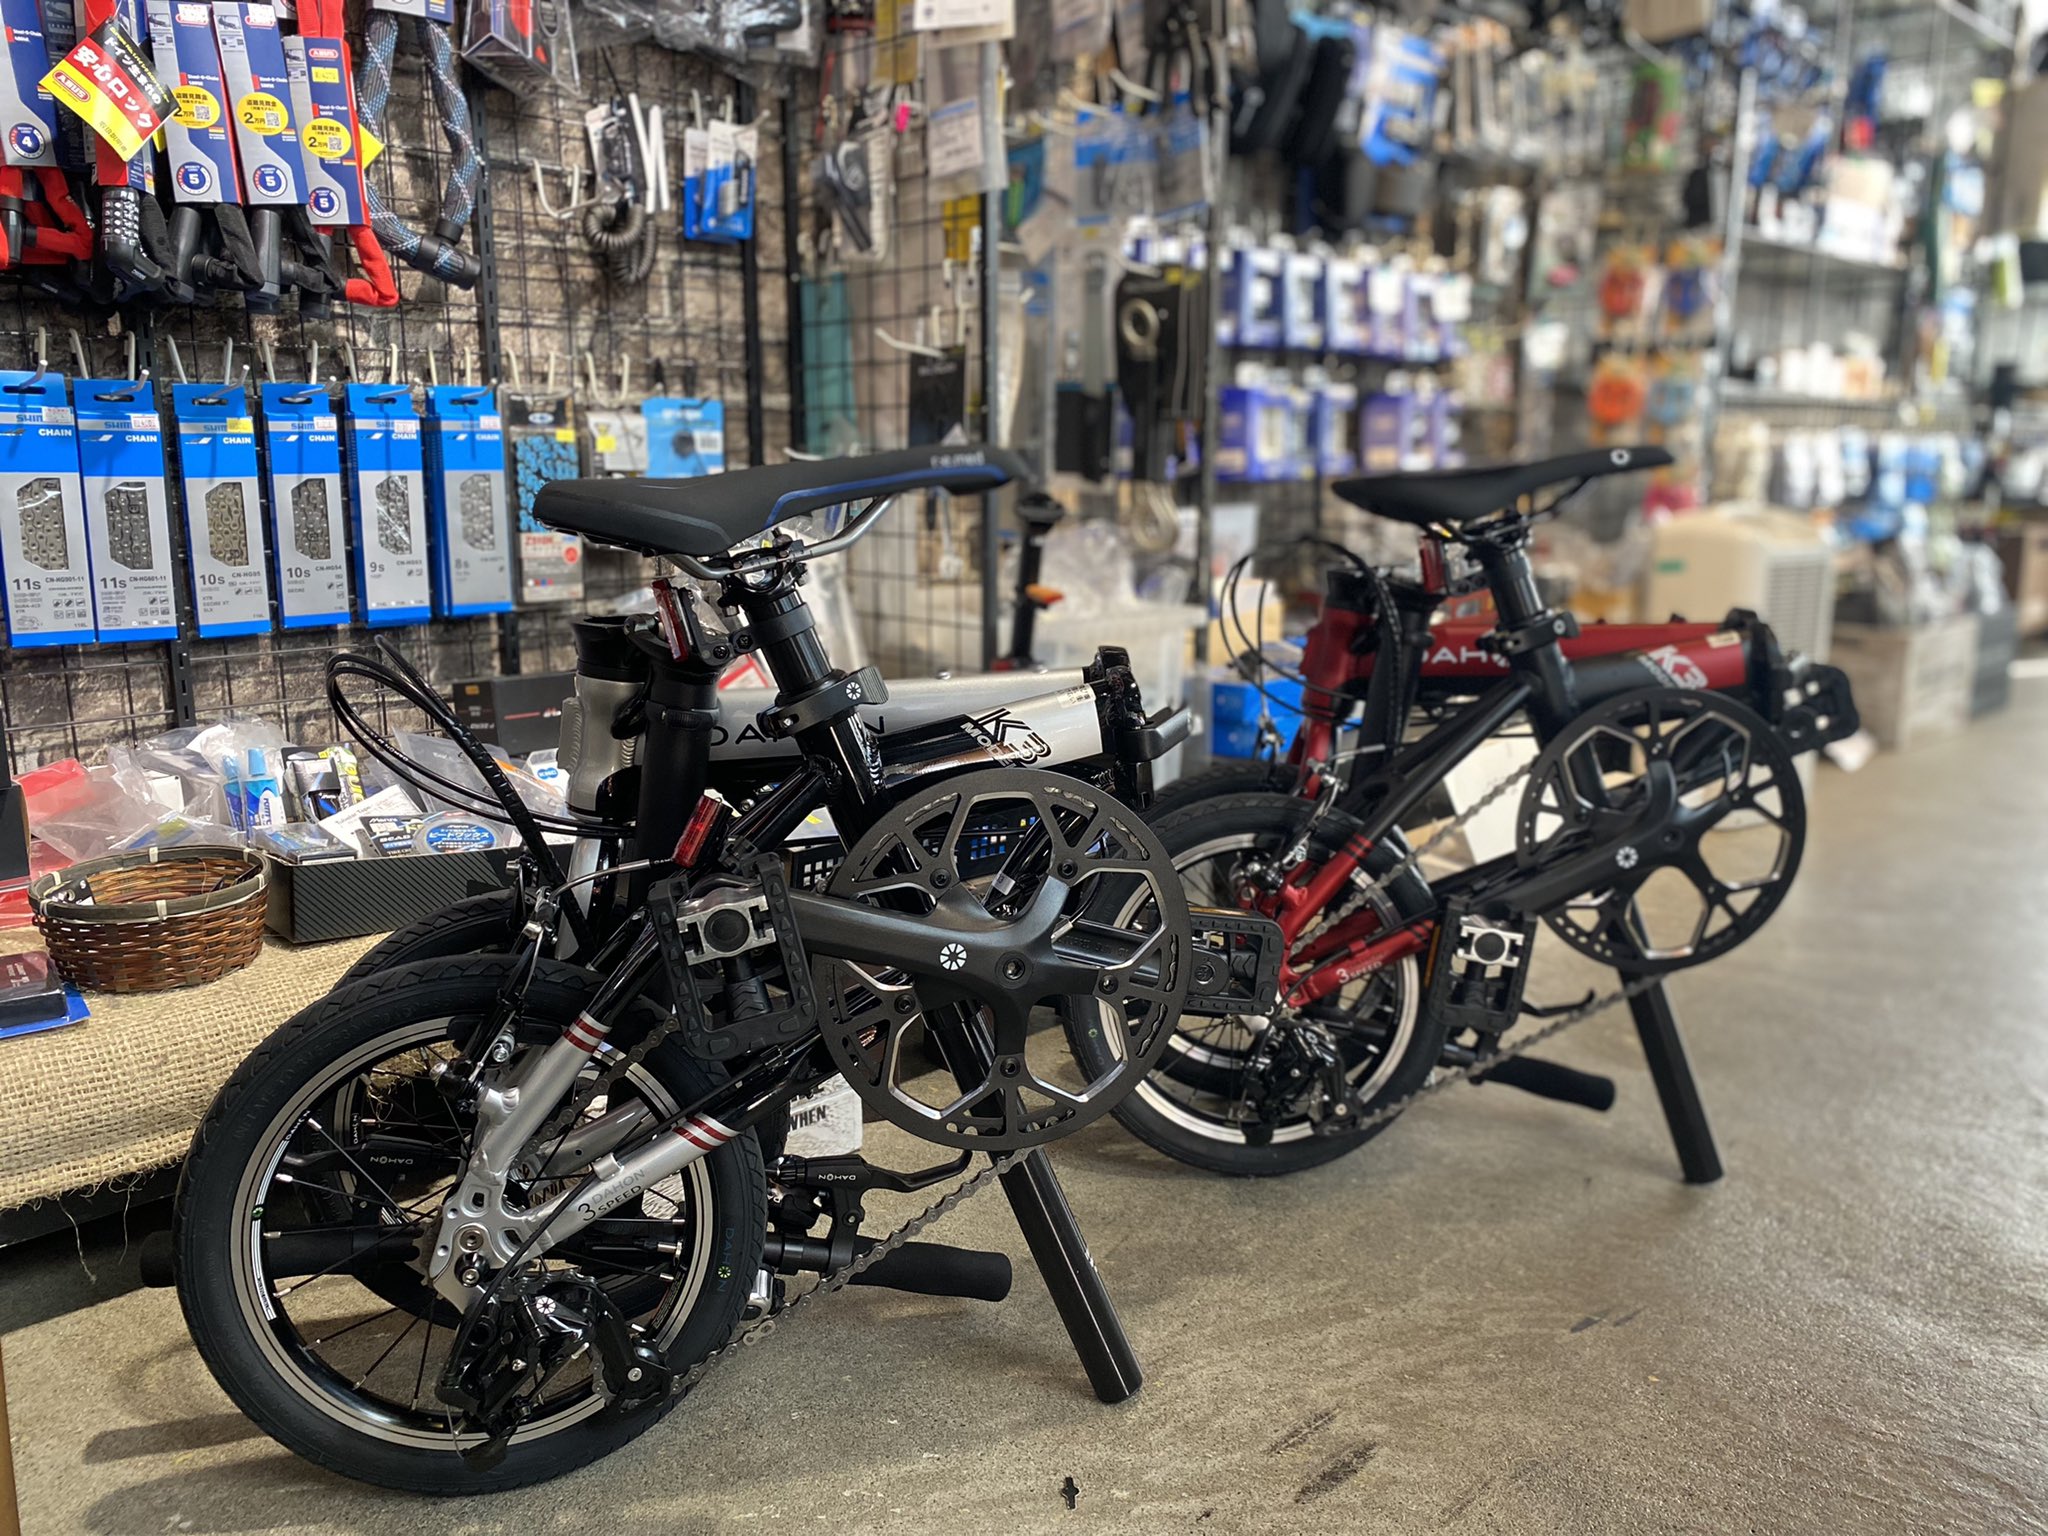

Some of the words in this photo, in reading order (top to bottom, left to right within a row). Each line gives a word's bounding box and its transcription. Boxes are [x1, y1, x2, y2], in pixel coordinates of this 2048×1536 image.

[104, 36, 161, 104] ドイツ生まれの
[74, 45, 153, 128] 安心ロック
[22, 136, 32, 148] 4
[189, 174, 200, 184] 5
[265, 176, 276, 186] 5
[320, 198, 329, 208] 5
[38, 428, 72, 436] CHAIN
[287, 567, 311, 578] 10s
[370, 562, 385, 573] 9s
[12, 578, 41, 590] 11s
[100, 577, 127, 589] 11s
[200, 574, 225, 585] 10s
[1336, 968, 1350, 984] 3
[370, 1156, 413, 1164] DAHON
[592, 1169, 645, 1204] DAHON
[578, 1203, 596, 1221] 3
[598, 1185, 642, 1212] SPEED
